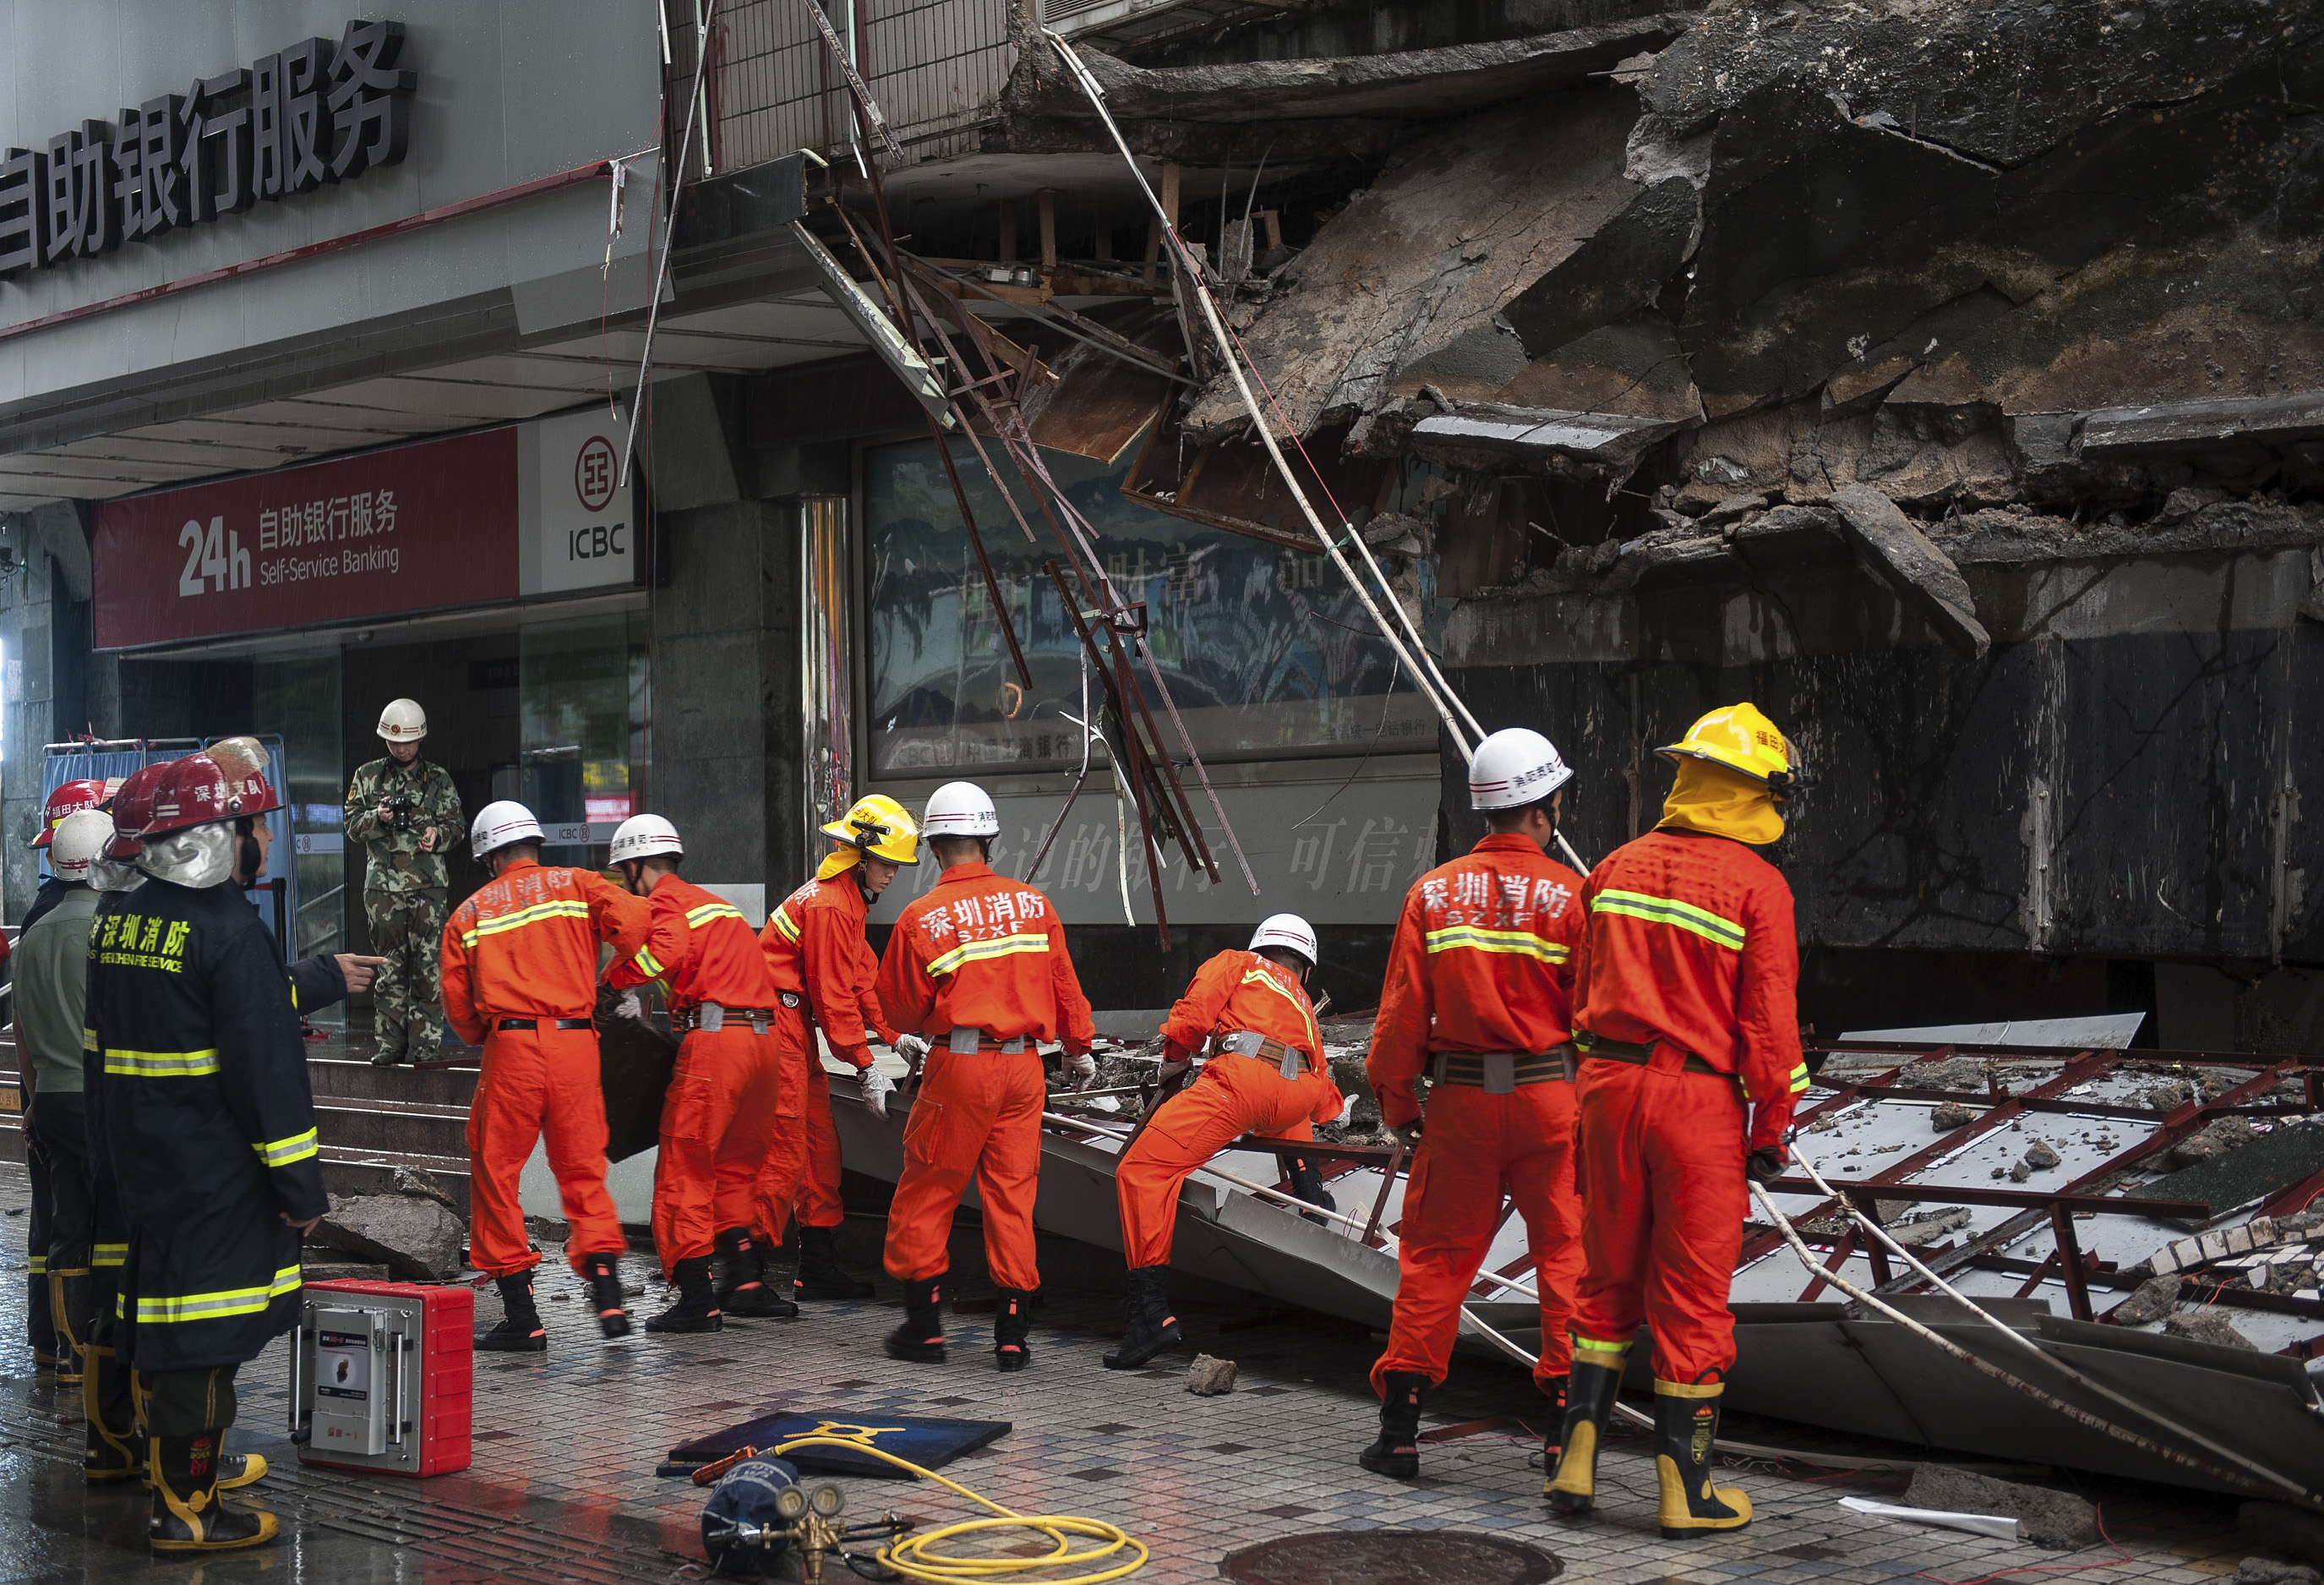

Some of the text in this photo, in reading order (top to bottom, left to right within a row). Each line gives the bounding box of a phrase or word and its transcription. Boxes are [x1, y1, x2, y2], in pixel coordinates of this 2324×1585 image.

[259, 489, 397, 551] 自助银行服务
[178, 515, 251, 597] 24h
[570, 522, 625, 561] ICBC
[260, 545, 399, 586] Self-Service Banking
[194, 779, 263, 803] 深圳支队
[559, 828, 577, 840] ICBC
[457, 870, 574, 923] 深圳消防
[1420, 872, 1573, 919] 深圳消防
[101, 914, 191, 957] 深圳消防
[919, 891, 1045, 943] 深圳消防
[957, 921, 1025, 943] SZXF
[1445, 910, 1535, 927] SZXF
